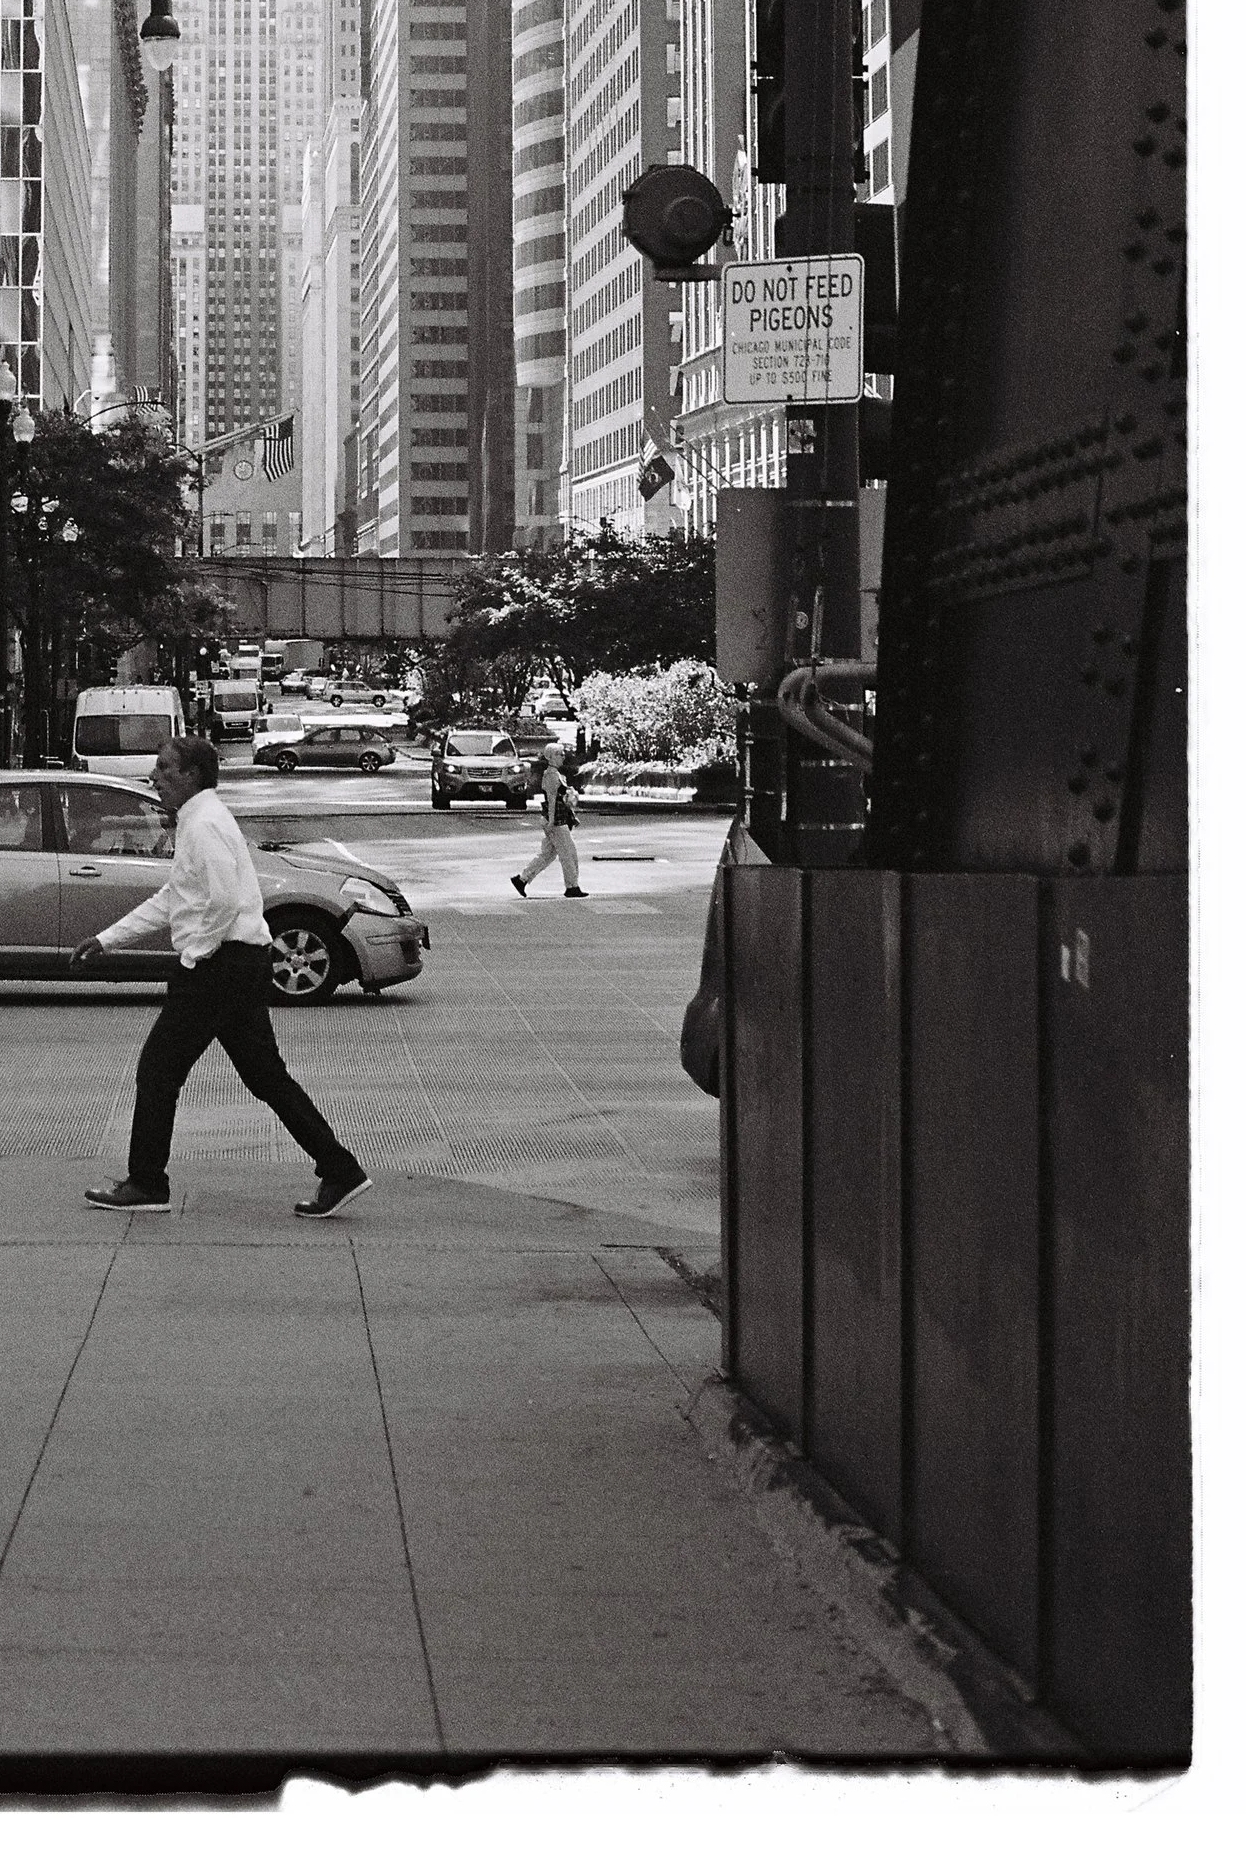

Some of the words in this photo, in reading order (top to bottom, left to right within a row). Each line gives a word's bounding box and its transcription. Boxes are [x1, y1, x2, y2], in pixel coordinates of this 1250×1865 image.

[732, 279, 756, 304] DO
[763, 276, 798, 302] NOT
[805, 273, 853, 299] FEED
[750, 304, 833, 332] PIGEONS
[732, 339, 770, 355] CHICAGO
[774, 337, 823, 352] MUNICIPAL
[828, 336, 851, 349] CODE
[753, 355, 789, 369] SECTION
[750, 372, 762, 385] UP
[767, 372, 777, 385] TO
[811, 369, 832, 383] FINE
